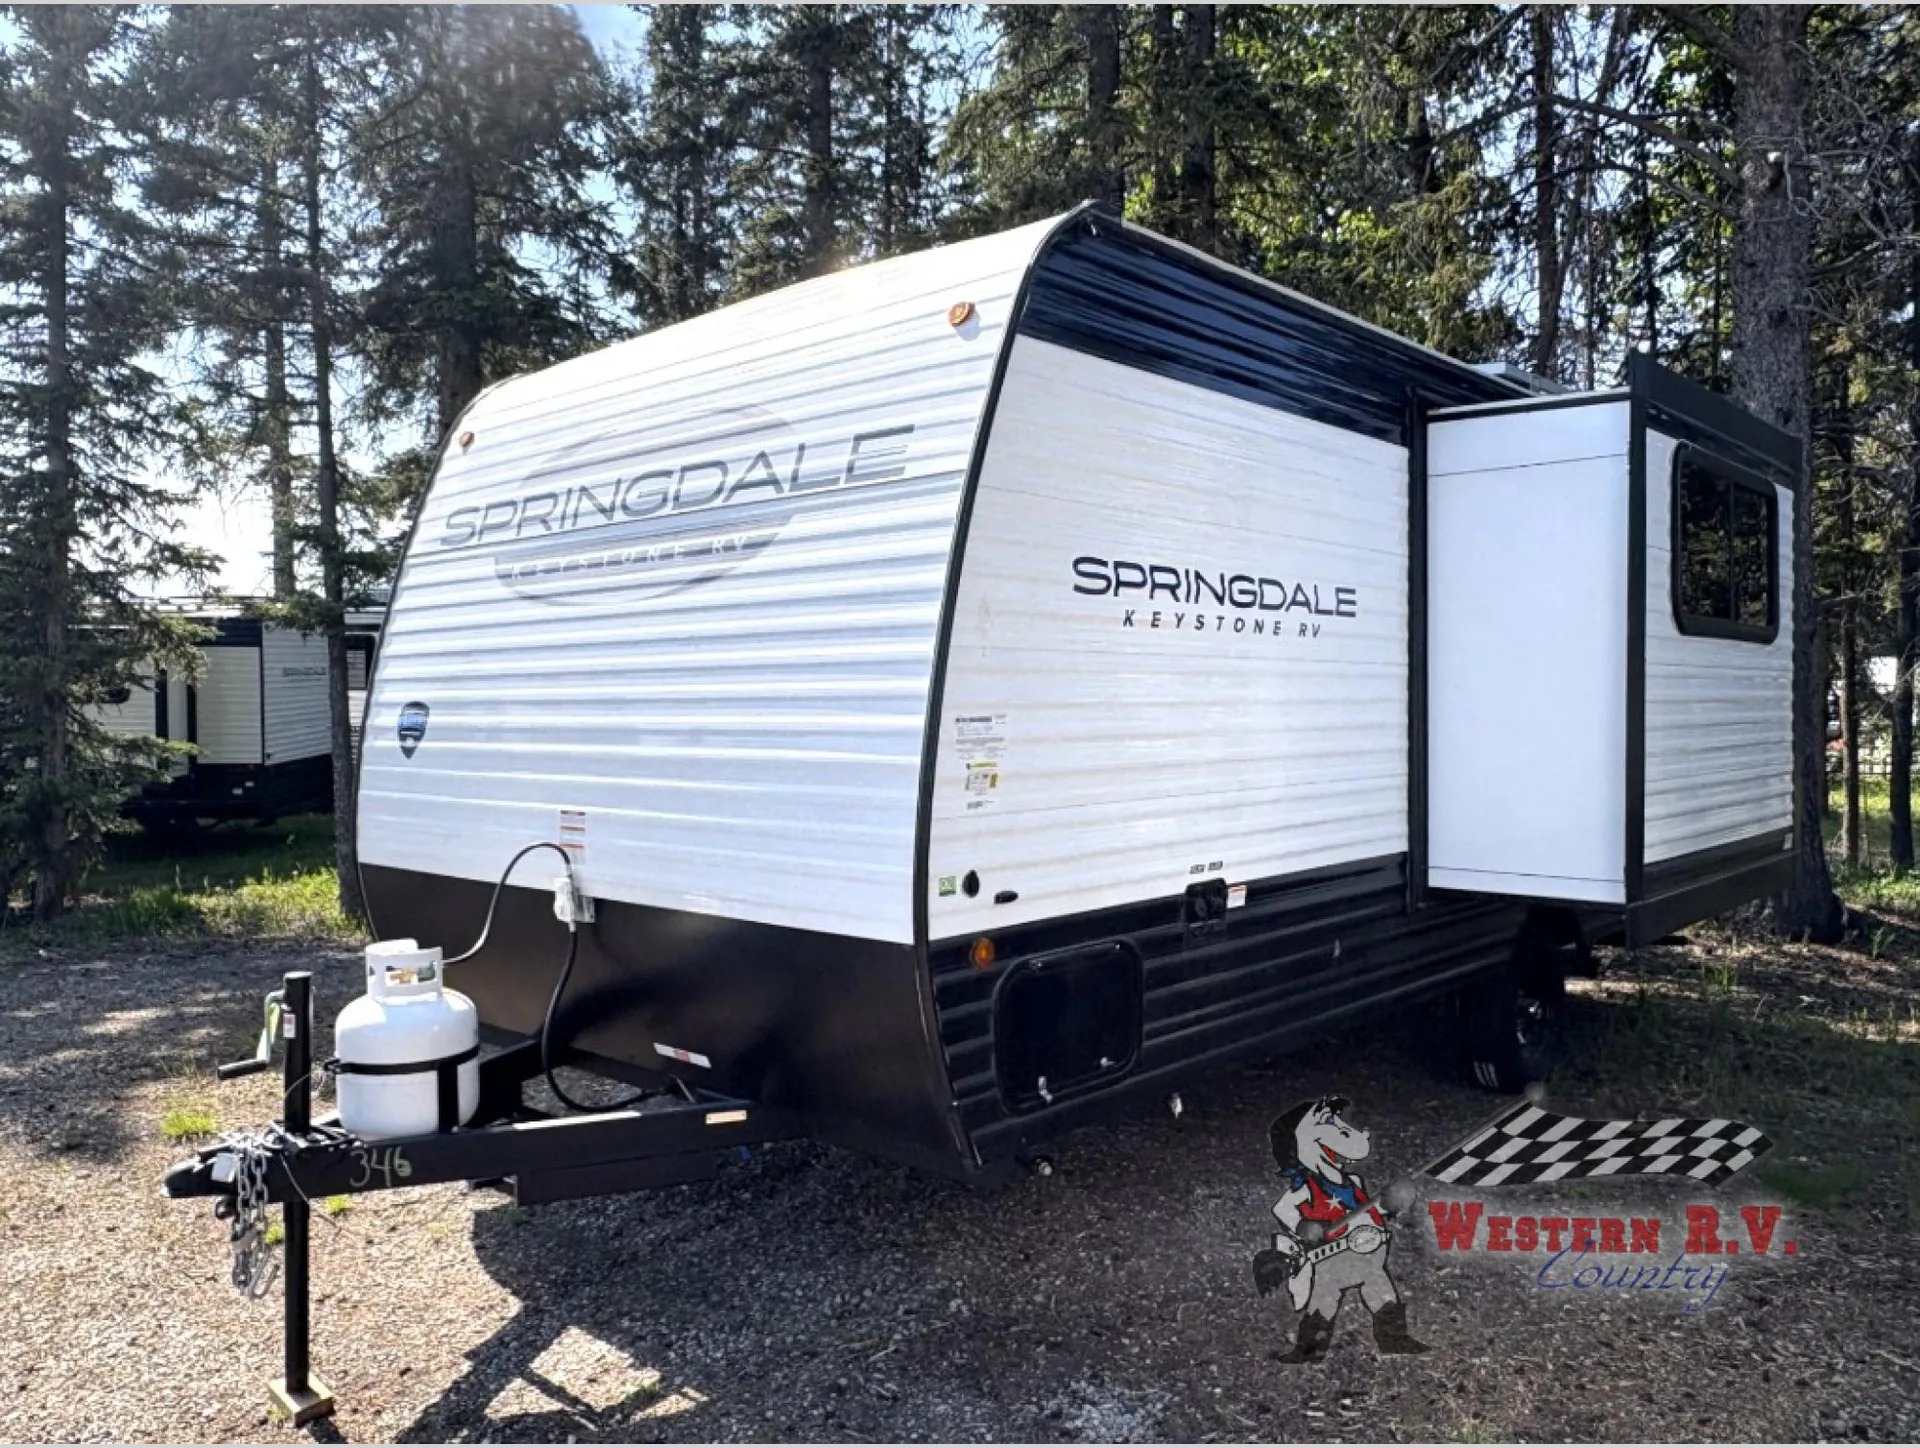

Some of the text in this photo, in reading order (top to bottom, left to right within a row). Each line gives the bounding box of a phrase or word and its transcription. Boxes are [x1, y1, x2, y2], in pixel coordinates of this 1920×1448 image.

[440, 423, 915, 548] SPRINGDALE
[1072, 556, 1357, 618] SPRINGDALE
[1122, 609, 1321, 638] KEYSTONE RV
[349, 1146, 412, 1188] 346
